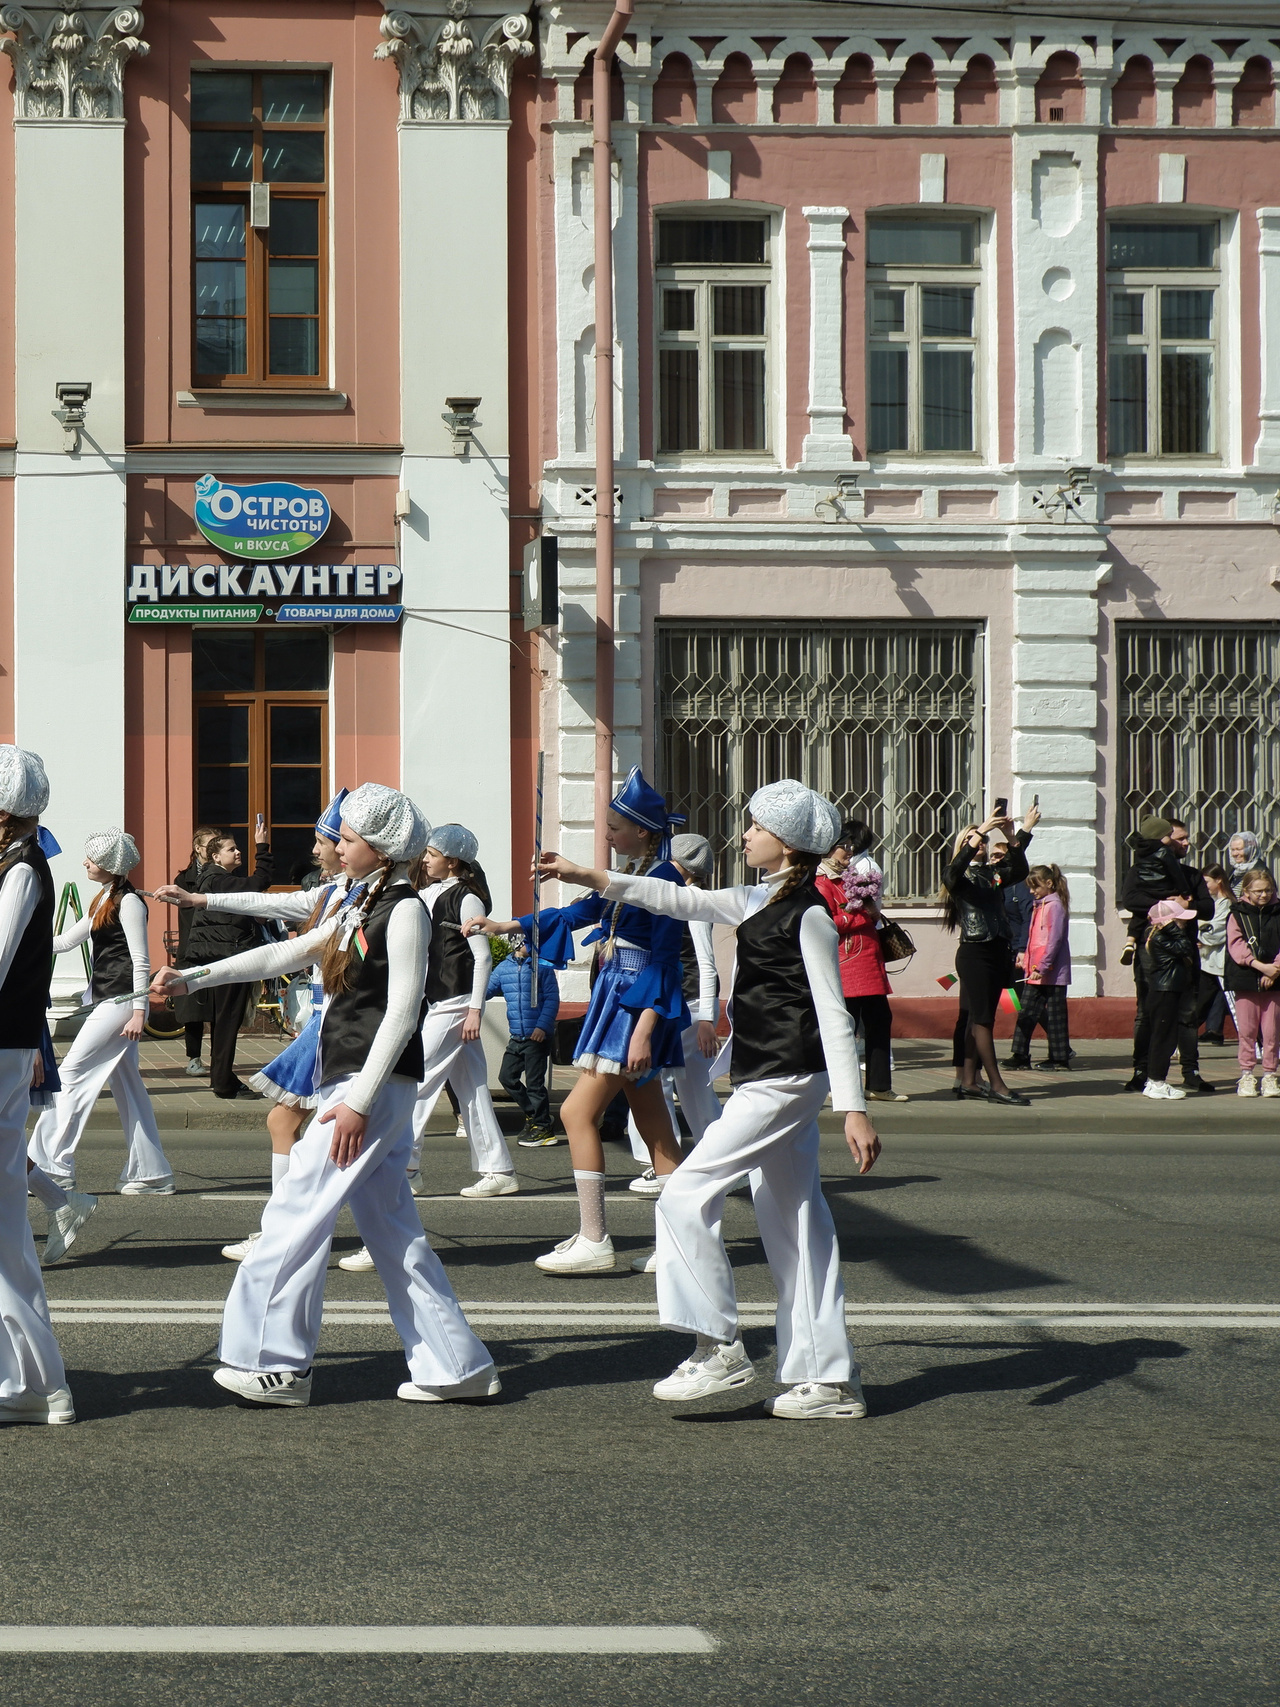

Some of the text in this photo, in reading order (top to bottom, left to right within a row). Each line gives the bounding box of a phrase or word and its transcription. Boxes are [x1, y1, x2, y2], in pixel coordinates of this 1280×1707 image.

[247, 518, 322, 532] ЧИСТОТЫ
[247, 540, 290, 551] ВКУСА
[127, 564, 402, 602] ДИСКАУНТЕР
[135, 608, 257, 619] ПРОДУКТЫ ПИТАНИЯ
[284, 608, 395, 619] ТОВАРЫ ДЛЯ ДОМА
